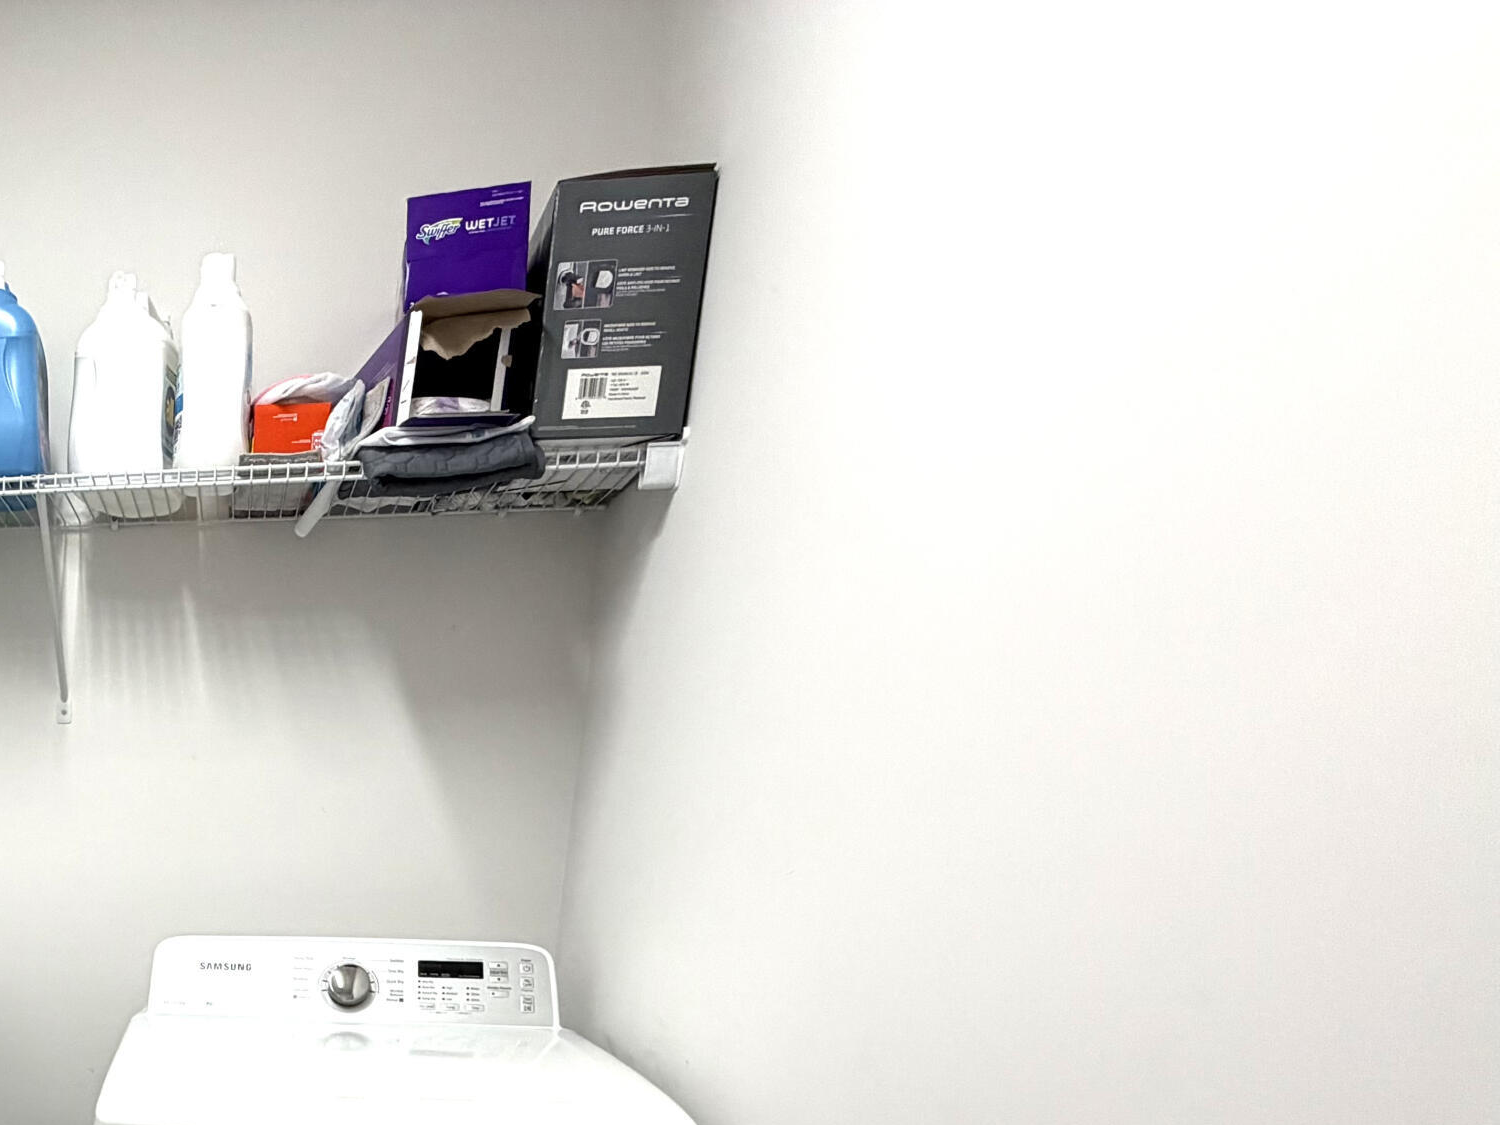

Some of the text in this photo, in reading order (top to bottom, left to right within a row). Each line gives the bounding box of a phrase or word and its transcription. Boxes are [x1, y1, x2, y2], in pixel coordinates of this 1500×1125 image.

[416, 220, 461, 240] Swiffer
[592, 227, 614, 236] PURE
[616, 225, 644, 235] FORCE
[200, 962, 252, 971] SAMSUNG
